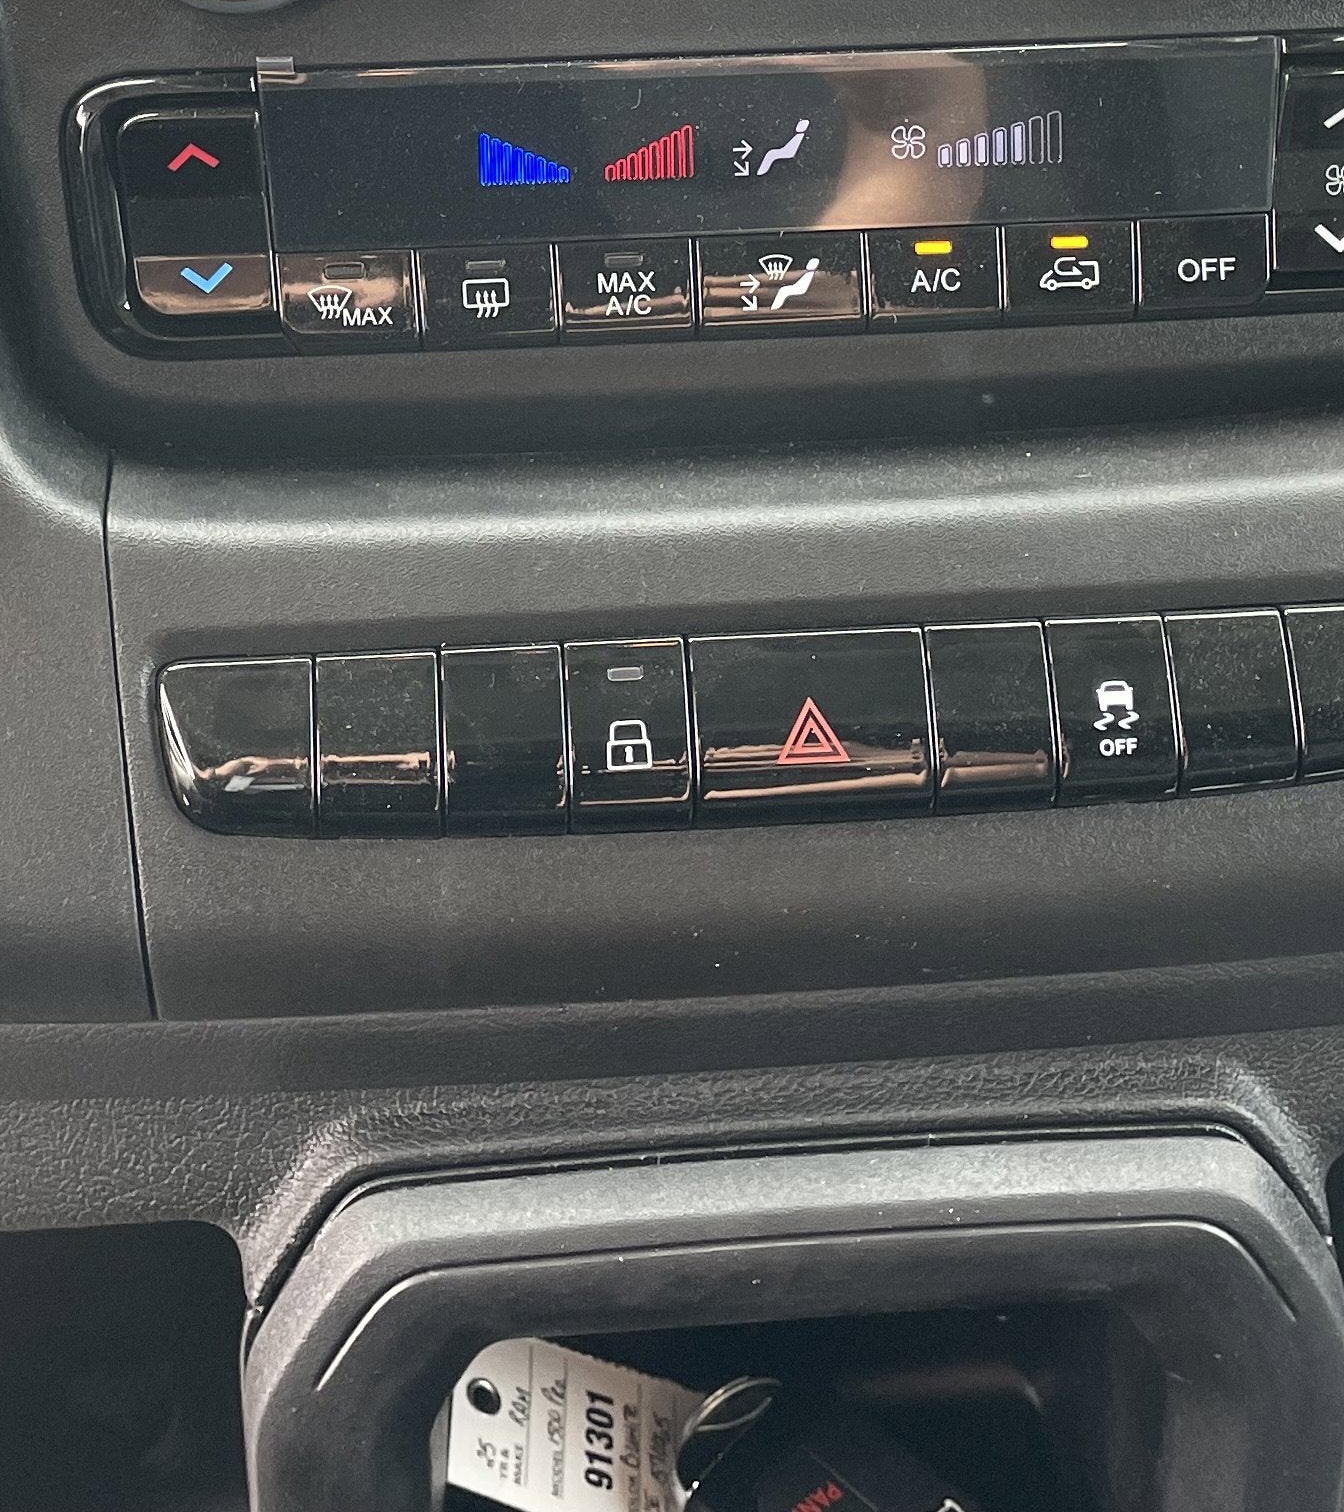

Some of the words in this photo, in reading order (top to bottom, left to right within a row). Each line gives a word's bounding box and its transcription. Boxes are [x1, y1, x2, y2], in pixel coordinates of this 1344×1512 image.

[911, 267, 961, 293] A/C
[1177, 258, 1236, 282] OFF
[597, 271, 657, 295] MAX
[341, 306, 393, 327] MAX
[604, 295, 652, 317] A/C
[1099, 737, 1138, 757] OFF
[584, 1389, 614, 1490] 91301
